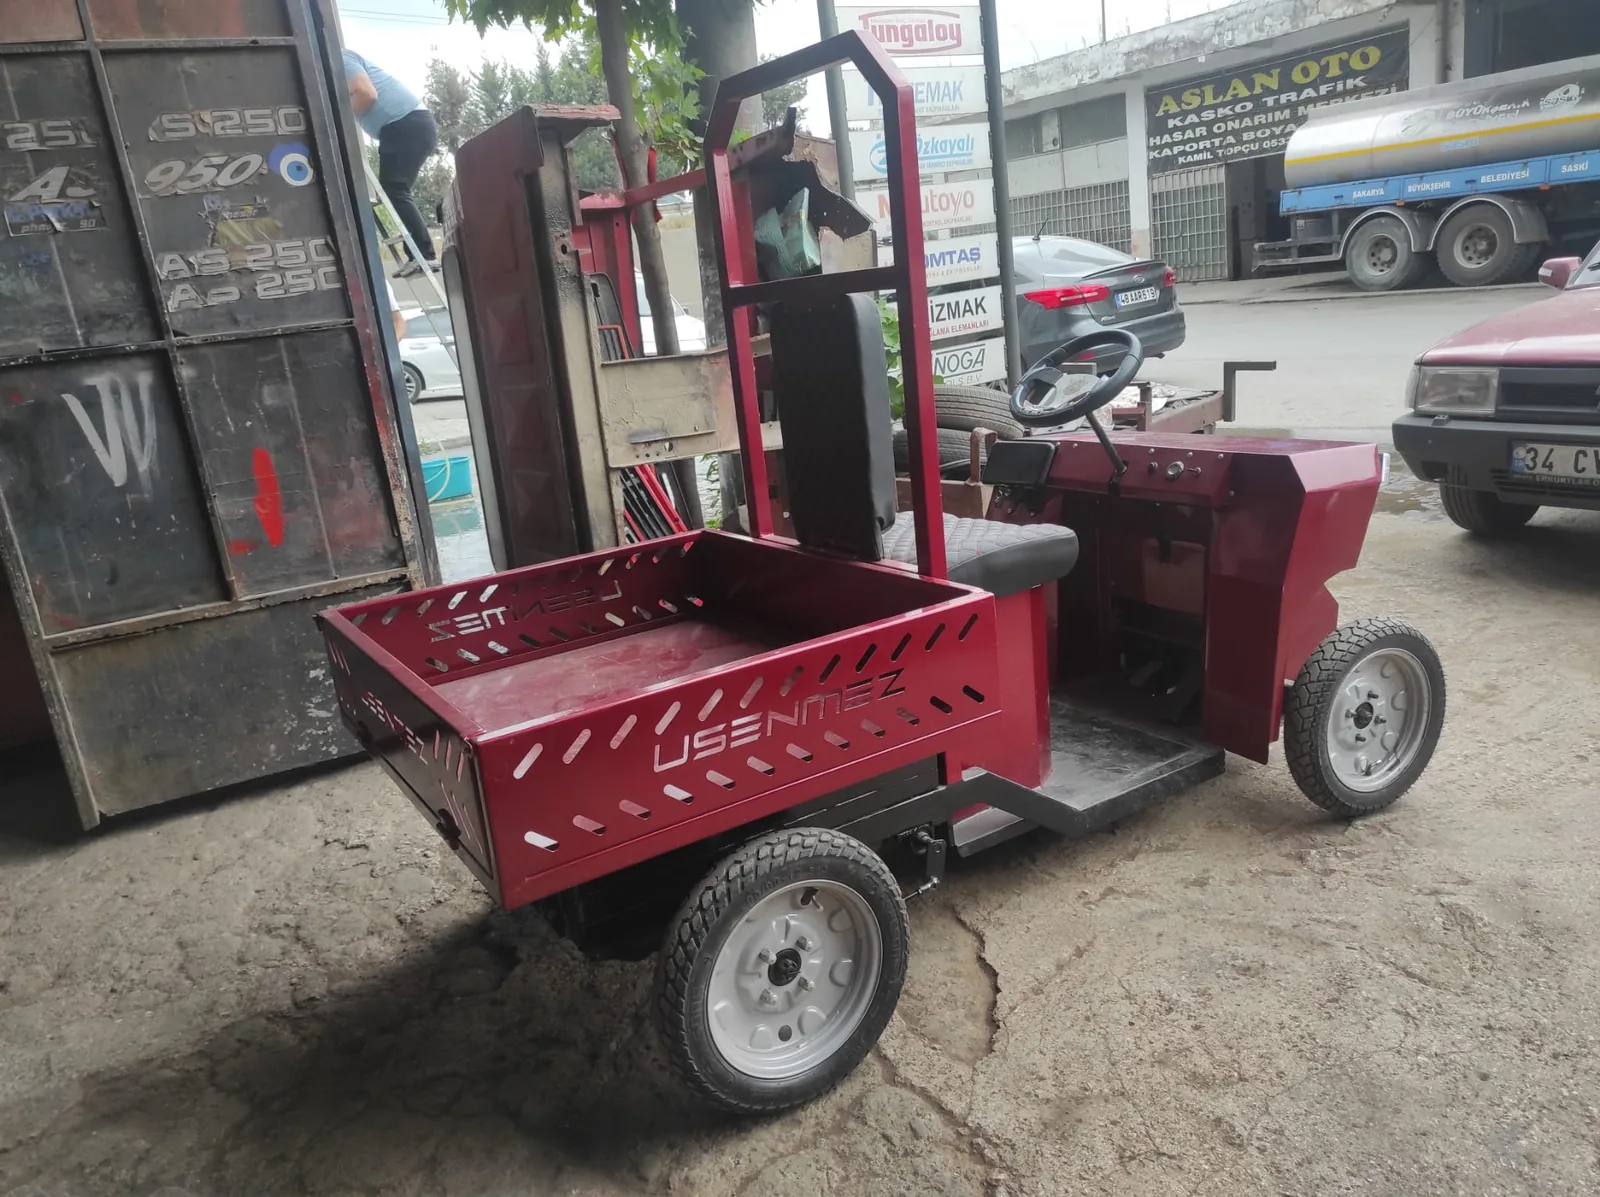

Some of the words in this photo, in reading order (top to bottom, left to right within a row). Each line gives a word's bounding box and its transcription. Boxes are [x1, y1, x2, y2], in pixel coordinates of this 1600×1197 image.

[1155, 67, 1281, 117] ASLAN
[1291, 45, 1382, 85] OTO
[1167, 101, 1254, 129] KASKO
[1261, 75, 1367, 107] TRAFİK
[211, 107, 306, 136] 250
[1148, 126, 1208, 147] HASAR
[1212, 108, 1291, 134] ONARIM
[1148, 137, 1237, 160] KAPORTA
[1178, 152, 1214, 165] KAMİL
[1216, 142, 1260, 155] TOPÇU
[145, 152, 265, 196] 950
[1352, 187, 1385, 199] SAKARYA
[1407, 180, 1451, 193] BÜYÜKŞEHİR
[1480, 168, 1530, 184] BELEDİYESİ
[1561, 161, 1589, 174] SASKİ
[159, 248, 231, 279] AS
[950, 319, 990, 333] ELEMANLARI
[934, 348, 985, 377] NOGA
[1525, 446, 1555, 472] 34
[653, 667, 907, 773] USENMEZ
